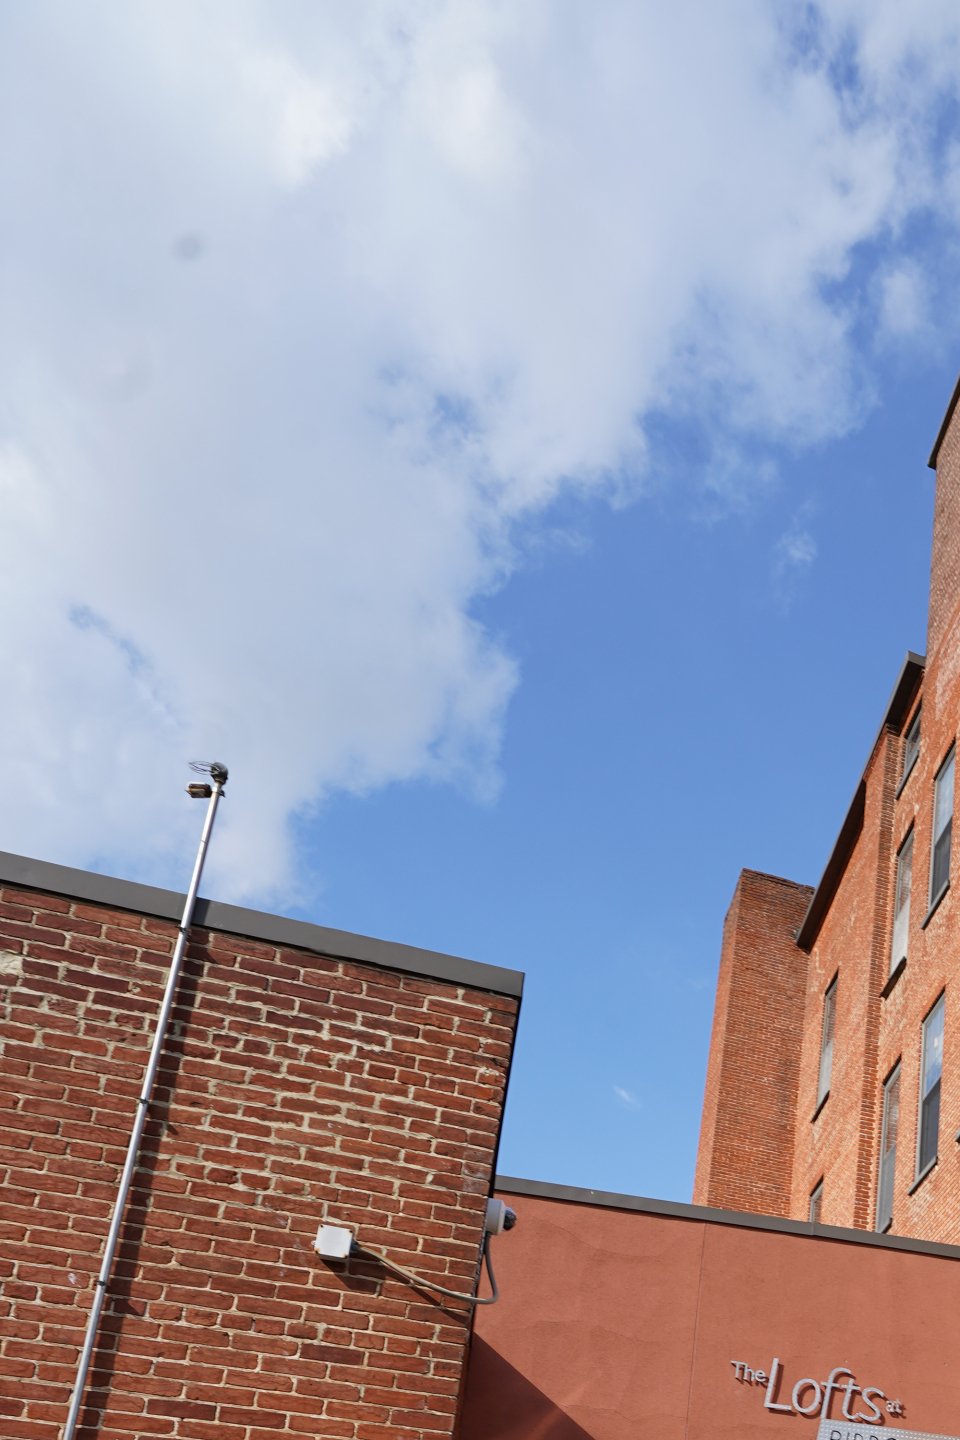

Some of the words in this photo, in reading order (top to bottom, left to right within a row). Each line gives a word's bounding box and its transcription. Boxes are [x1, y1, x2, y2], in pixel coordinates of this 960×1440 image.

[730, 1360, 767, 1382] The
[764, 1358, 885, 1422] Lofts
[885, 1399, 903, 1413] at
